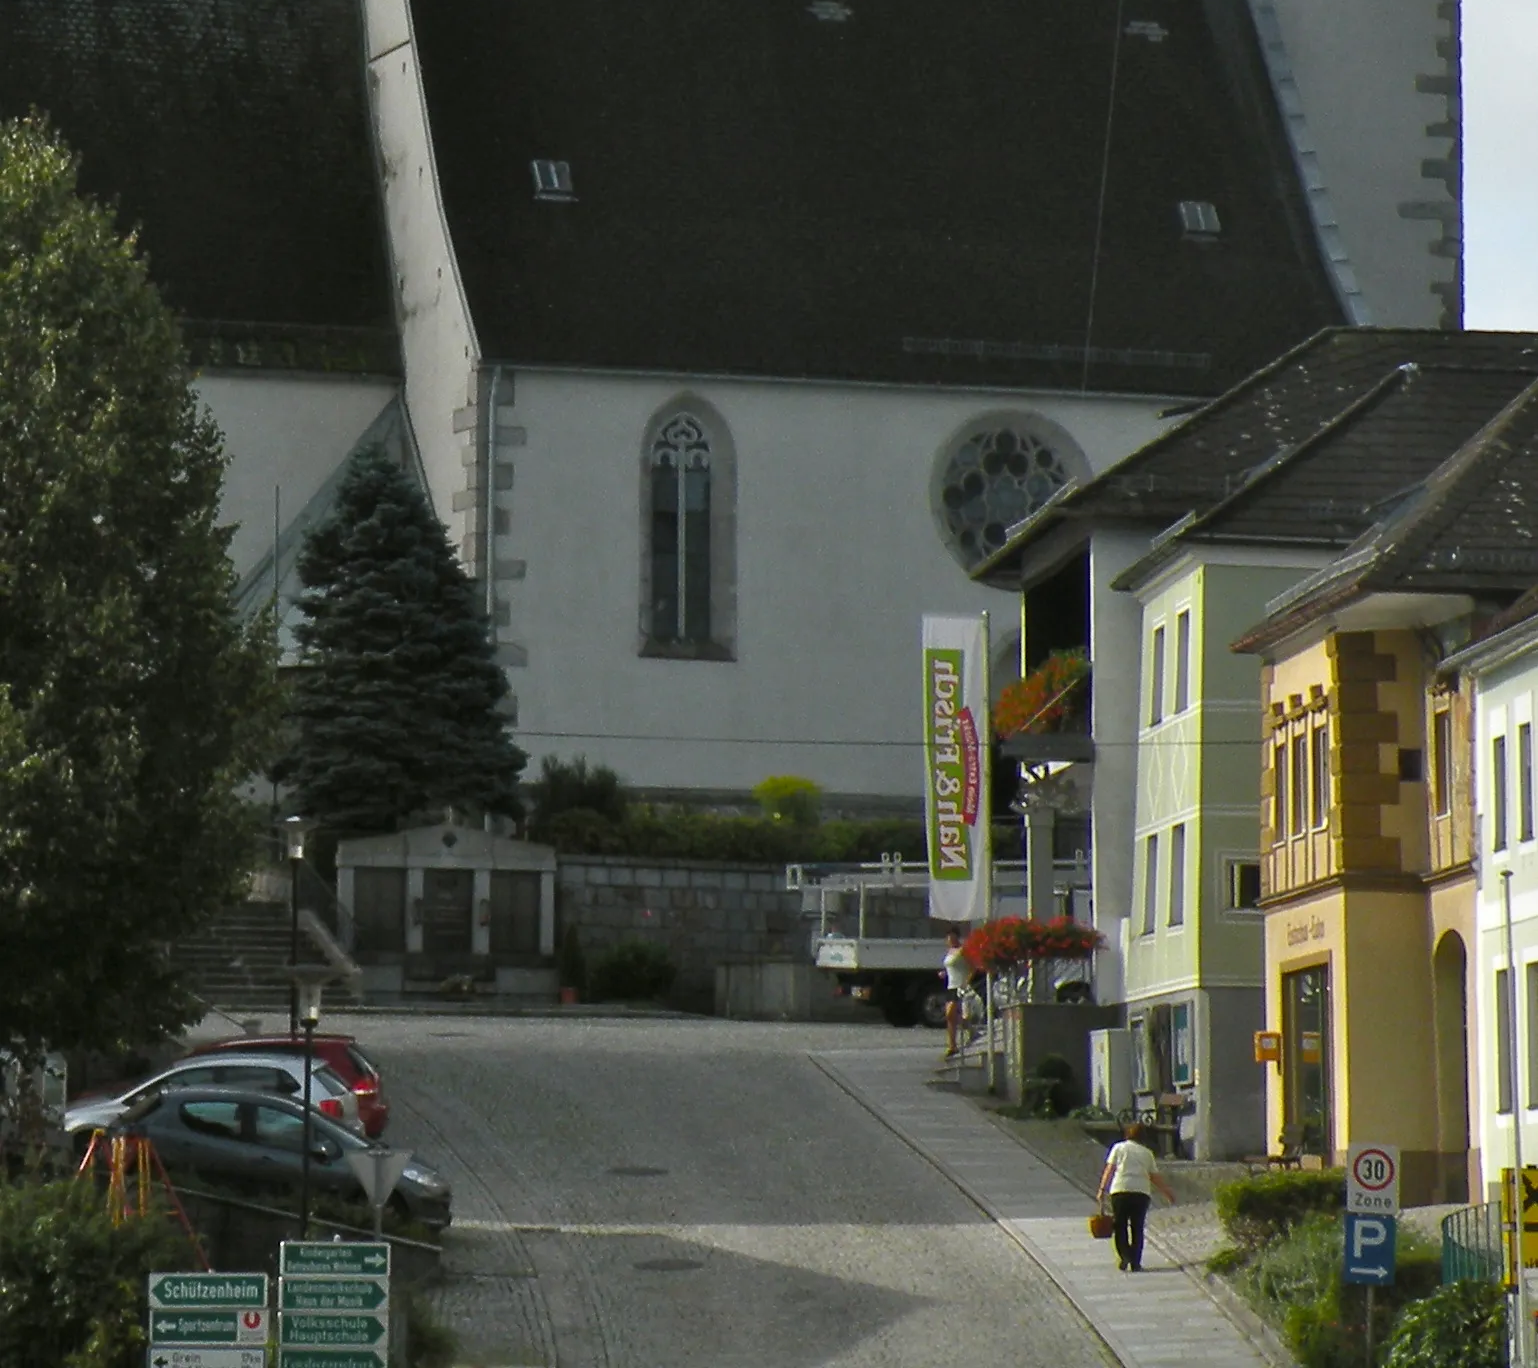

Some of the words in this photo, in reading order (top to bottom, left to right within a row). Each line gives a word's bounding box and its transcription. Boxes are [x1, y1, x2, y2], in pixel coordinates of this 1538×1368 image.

[1362, 1159, 1385, 1182] 30
[1354, 1192, 1392, 1209] Zone
[1353, 1219, 1387, 1258] P
[164, 1280, 259, 1300] Schützenheim
[291, 1316, 368, 1329] Volksschule
[289, 1330, 370, 1343] Hauptschule
